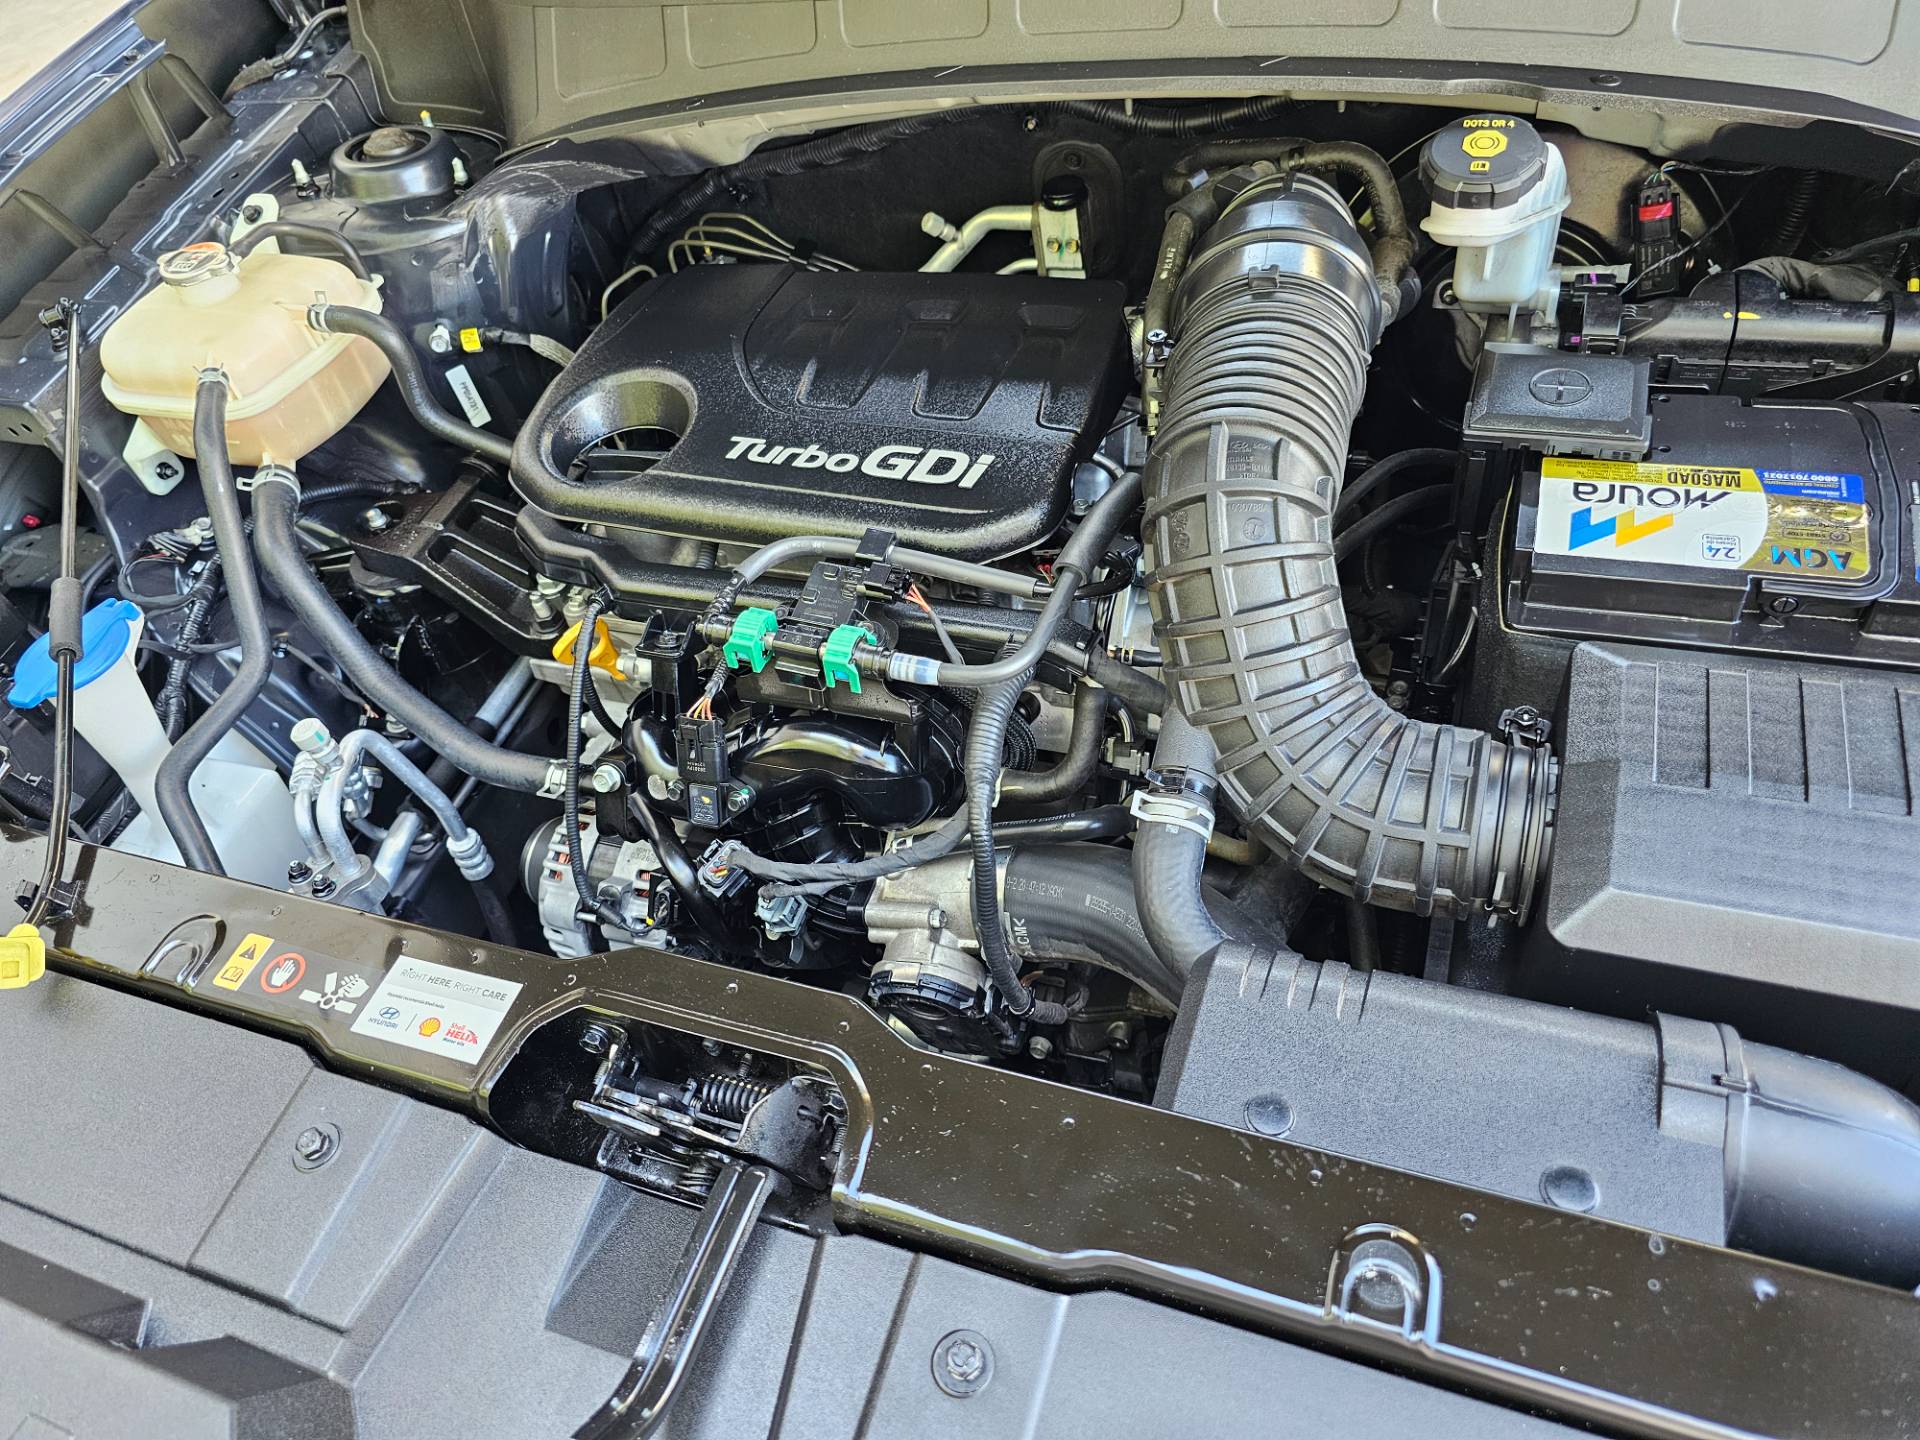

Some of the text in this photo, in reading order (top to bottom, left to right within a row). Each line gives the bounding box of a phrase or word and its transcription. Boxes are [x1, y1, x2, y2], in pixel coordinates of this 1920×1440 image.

[1462, 119, 1515, 129] DOT3 OR 4
[725, 436, 996, 489] Turbo GDi
[1667, 471, 1741, 488] MA60AD
[1770, 544, 1852, 571] AGM
[453, 981, 481, 995] RIGHT
[481, 989, 508, 1002] CARE
[444, 1028, 480, 1045] HELIX
